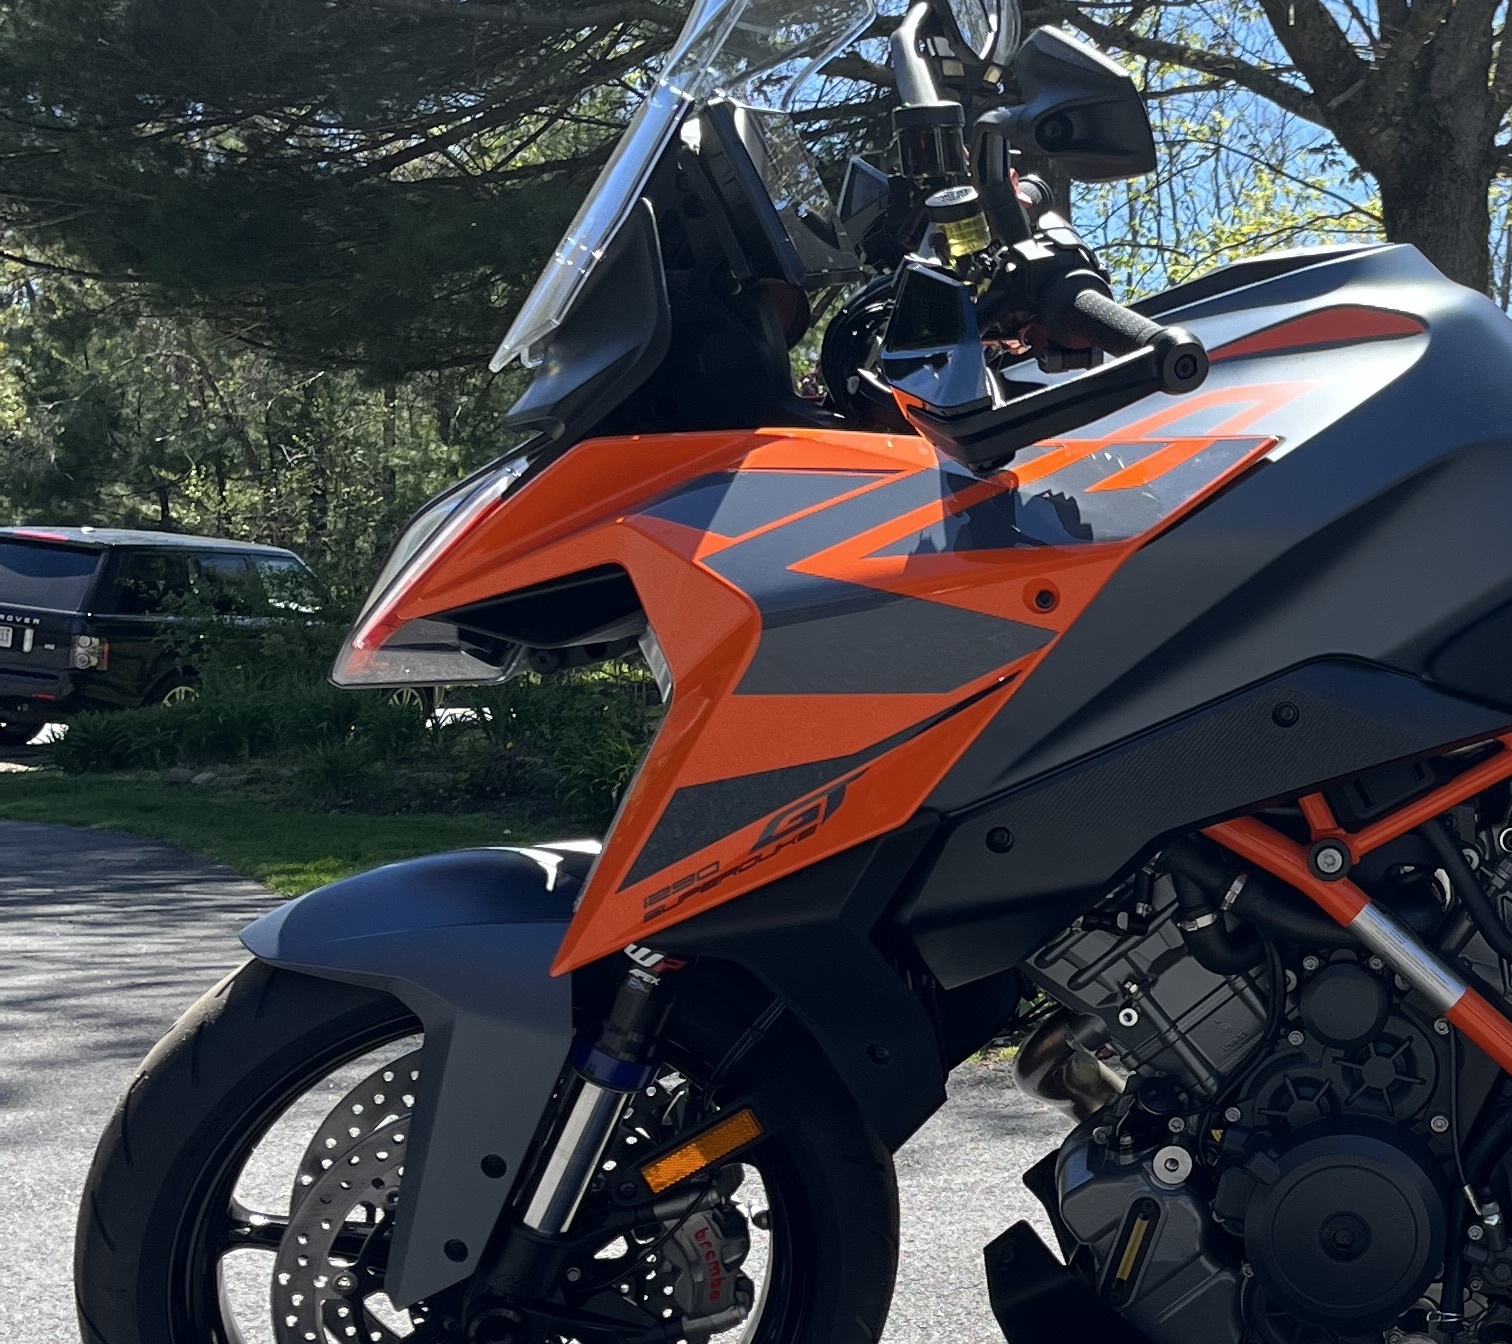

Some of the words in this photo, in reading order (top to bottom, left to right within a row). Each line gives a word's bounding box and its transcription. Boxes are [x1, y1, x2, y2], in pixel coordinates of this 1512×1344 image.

[748, 767, 870, 854] GT
[643, 861, 720, 909] 1290
[629, 968, 662, 986] APEX
[694, 1226, 726, 1302] brembo
